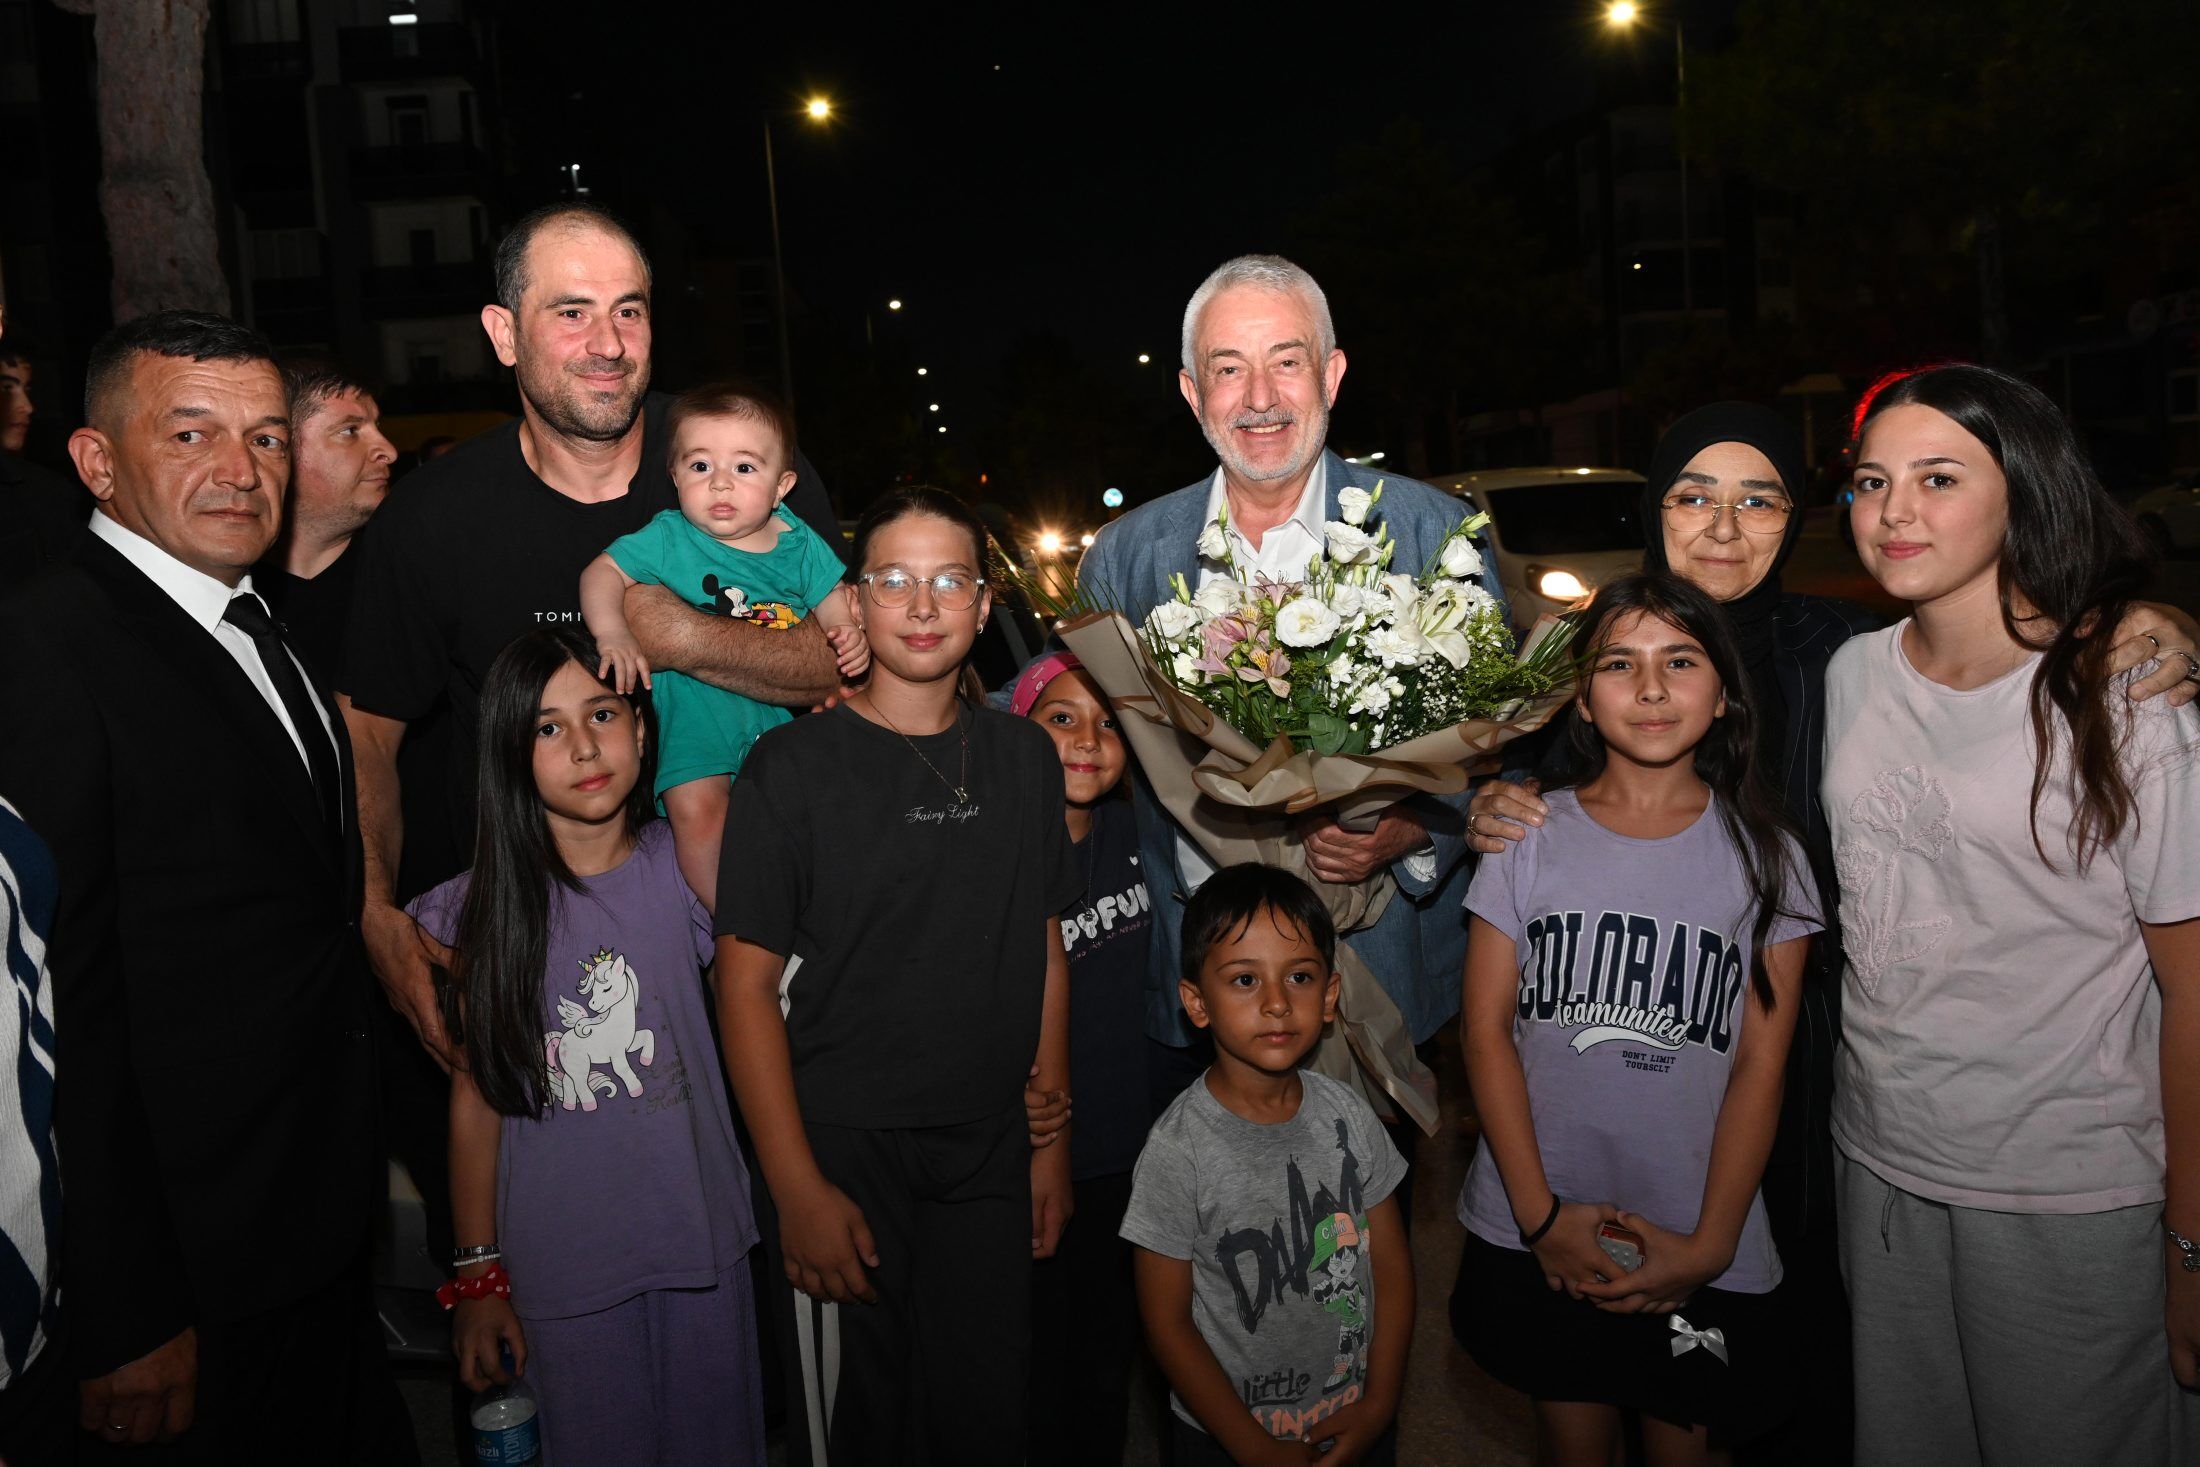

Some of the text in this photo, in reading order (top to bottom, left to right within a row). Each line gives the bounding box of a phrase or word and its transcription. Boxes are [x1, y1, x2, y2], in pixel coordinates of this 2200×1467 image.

[947, 803, 979, 823] Light
[1517, 910, 1743, 1055] COLORADO
[1555, 998, 1693, 1045] teamunited
[1622, 1050, 1676, 1064] DONT LIMIT
[1243, 1367, 1311, 1408] little
